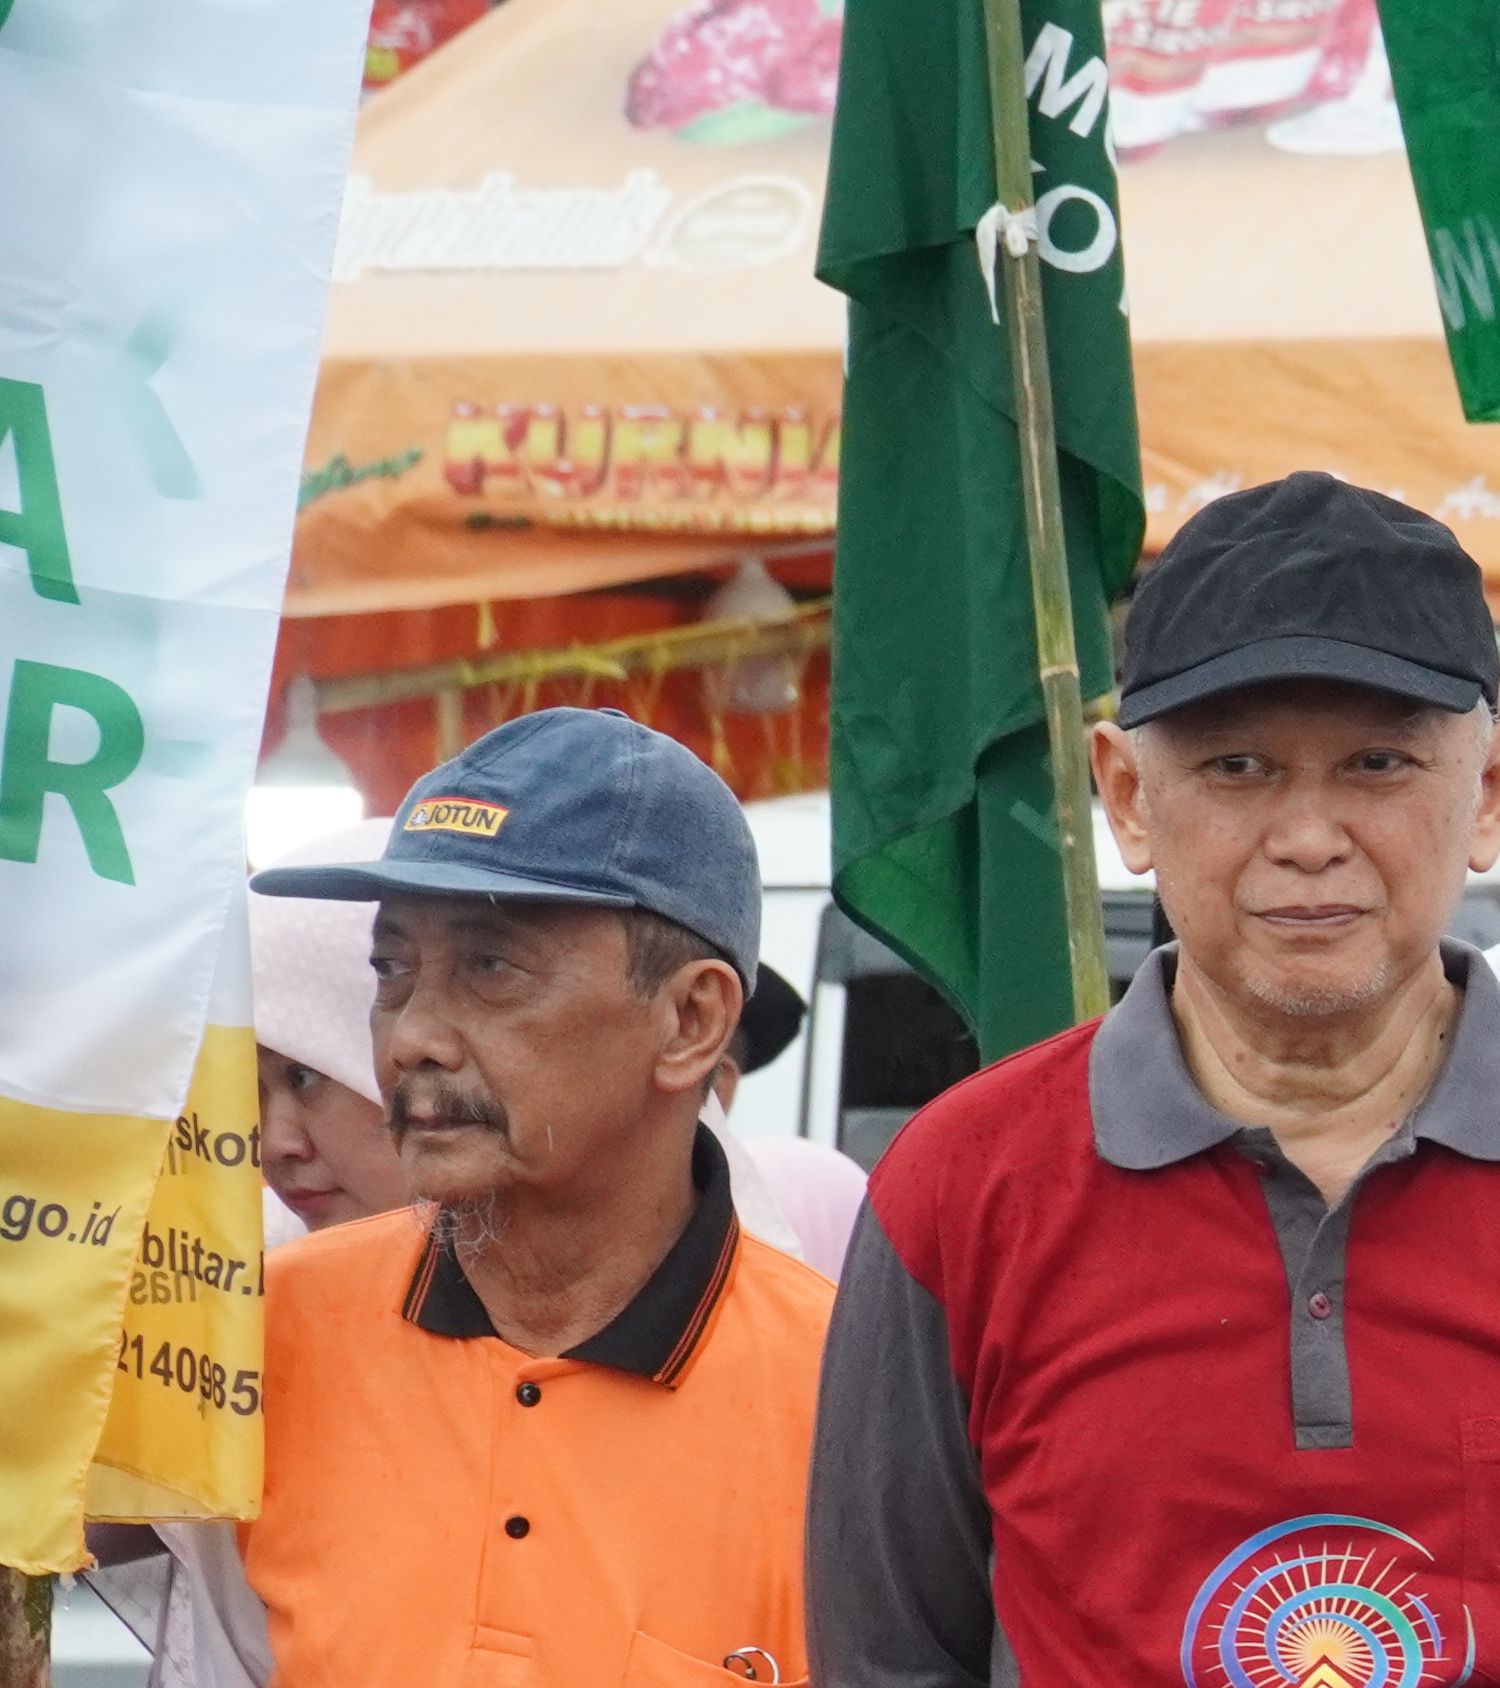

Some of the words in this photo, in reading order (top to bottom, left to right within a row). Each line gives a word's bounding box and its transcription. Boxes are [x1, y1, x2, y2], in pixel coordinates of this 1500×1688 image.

[426, 804, 499, 830] JOTUN
[0, 1194, 123, 1246] go.id
[142, 1221, 265, 1297] blitar.
[117, 1328, 265, 1417] 2140985
